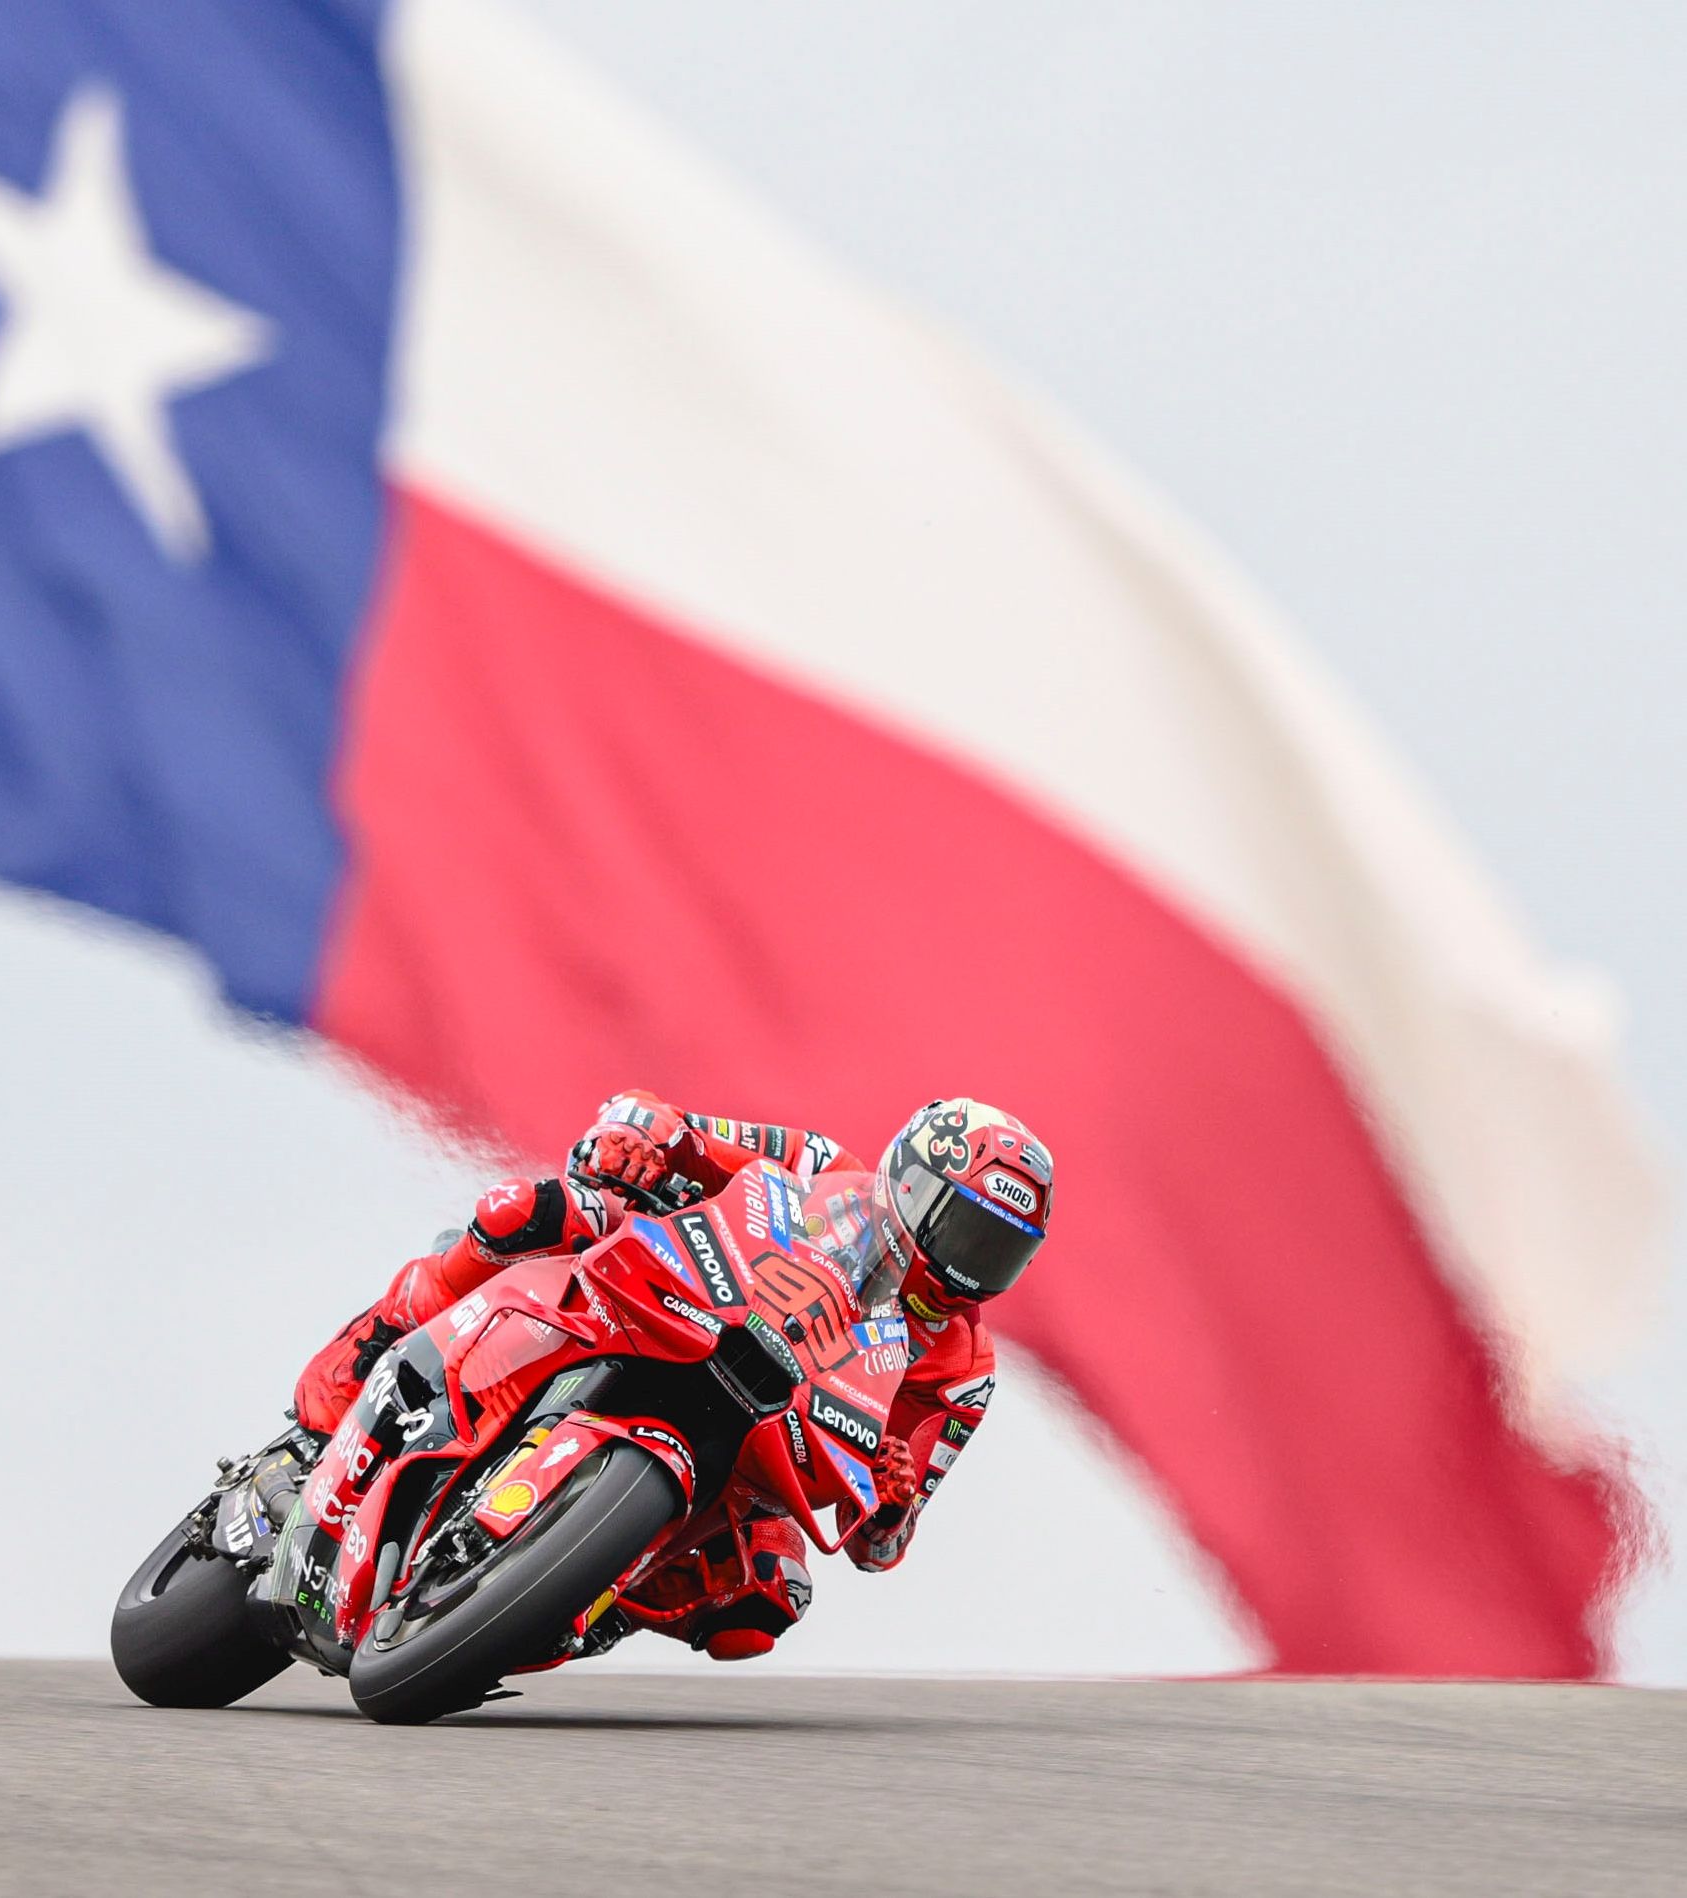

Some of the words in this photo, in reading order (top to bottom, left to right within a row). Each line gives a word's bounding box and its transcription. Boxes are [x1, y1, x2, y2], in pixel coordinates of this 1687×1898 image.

[742, 1177, 770, 1241] riello
[992, 1177, 1032, 1209] SHOEI
[654, 1242, 683, 1274] TIM
[682, 1215, 734, 1303] Lenovo
[881, 1218, 907, 1269] Lenovo
[576, 1271, 596, 1297] Audi
[590, 1297, 617, 1336] Sport
[809, 1250, 858, 1312] VARGROUP
[945, 1264, 980, 1290] Insta360
[663, 1295, 723, 1336] CARRERA
[750, 1251, 860, 1374] 93
[761, 1324, 805, 1386] MONSTER
[786, 1410, 807, 1464] CARRERA
[812, 1394, 878, 1451] Lenovo
